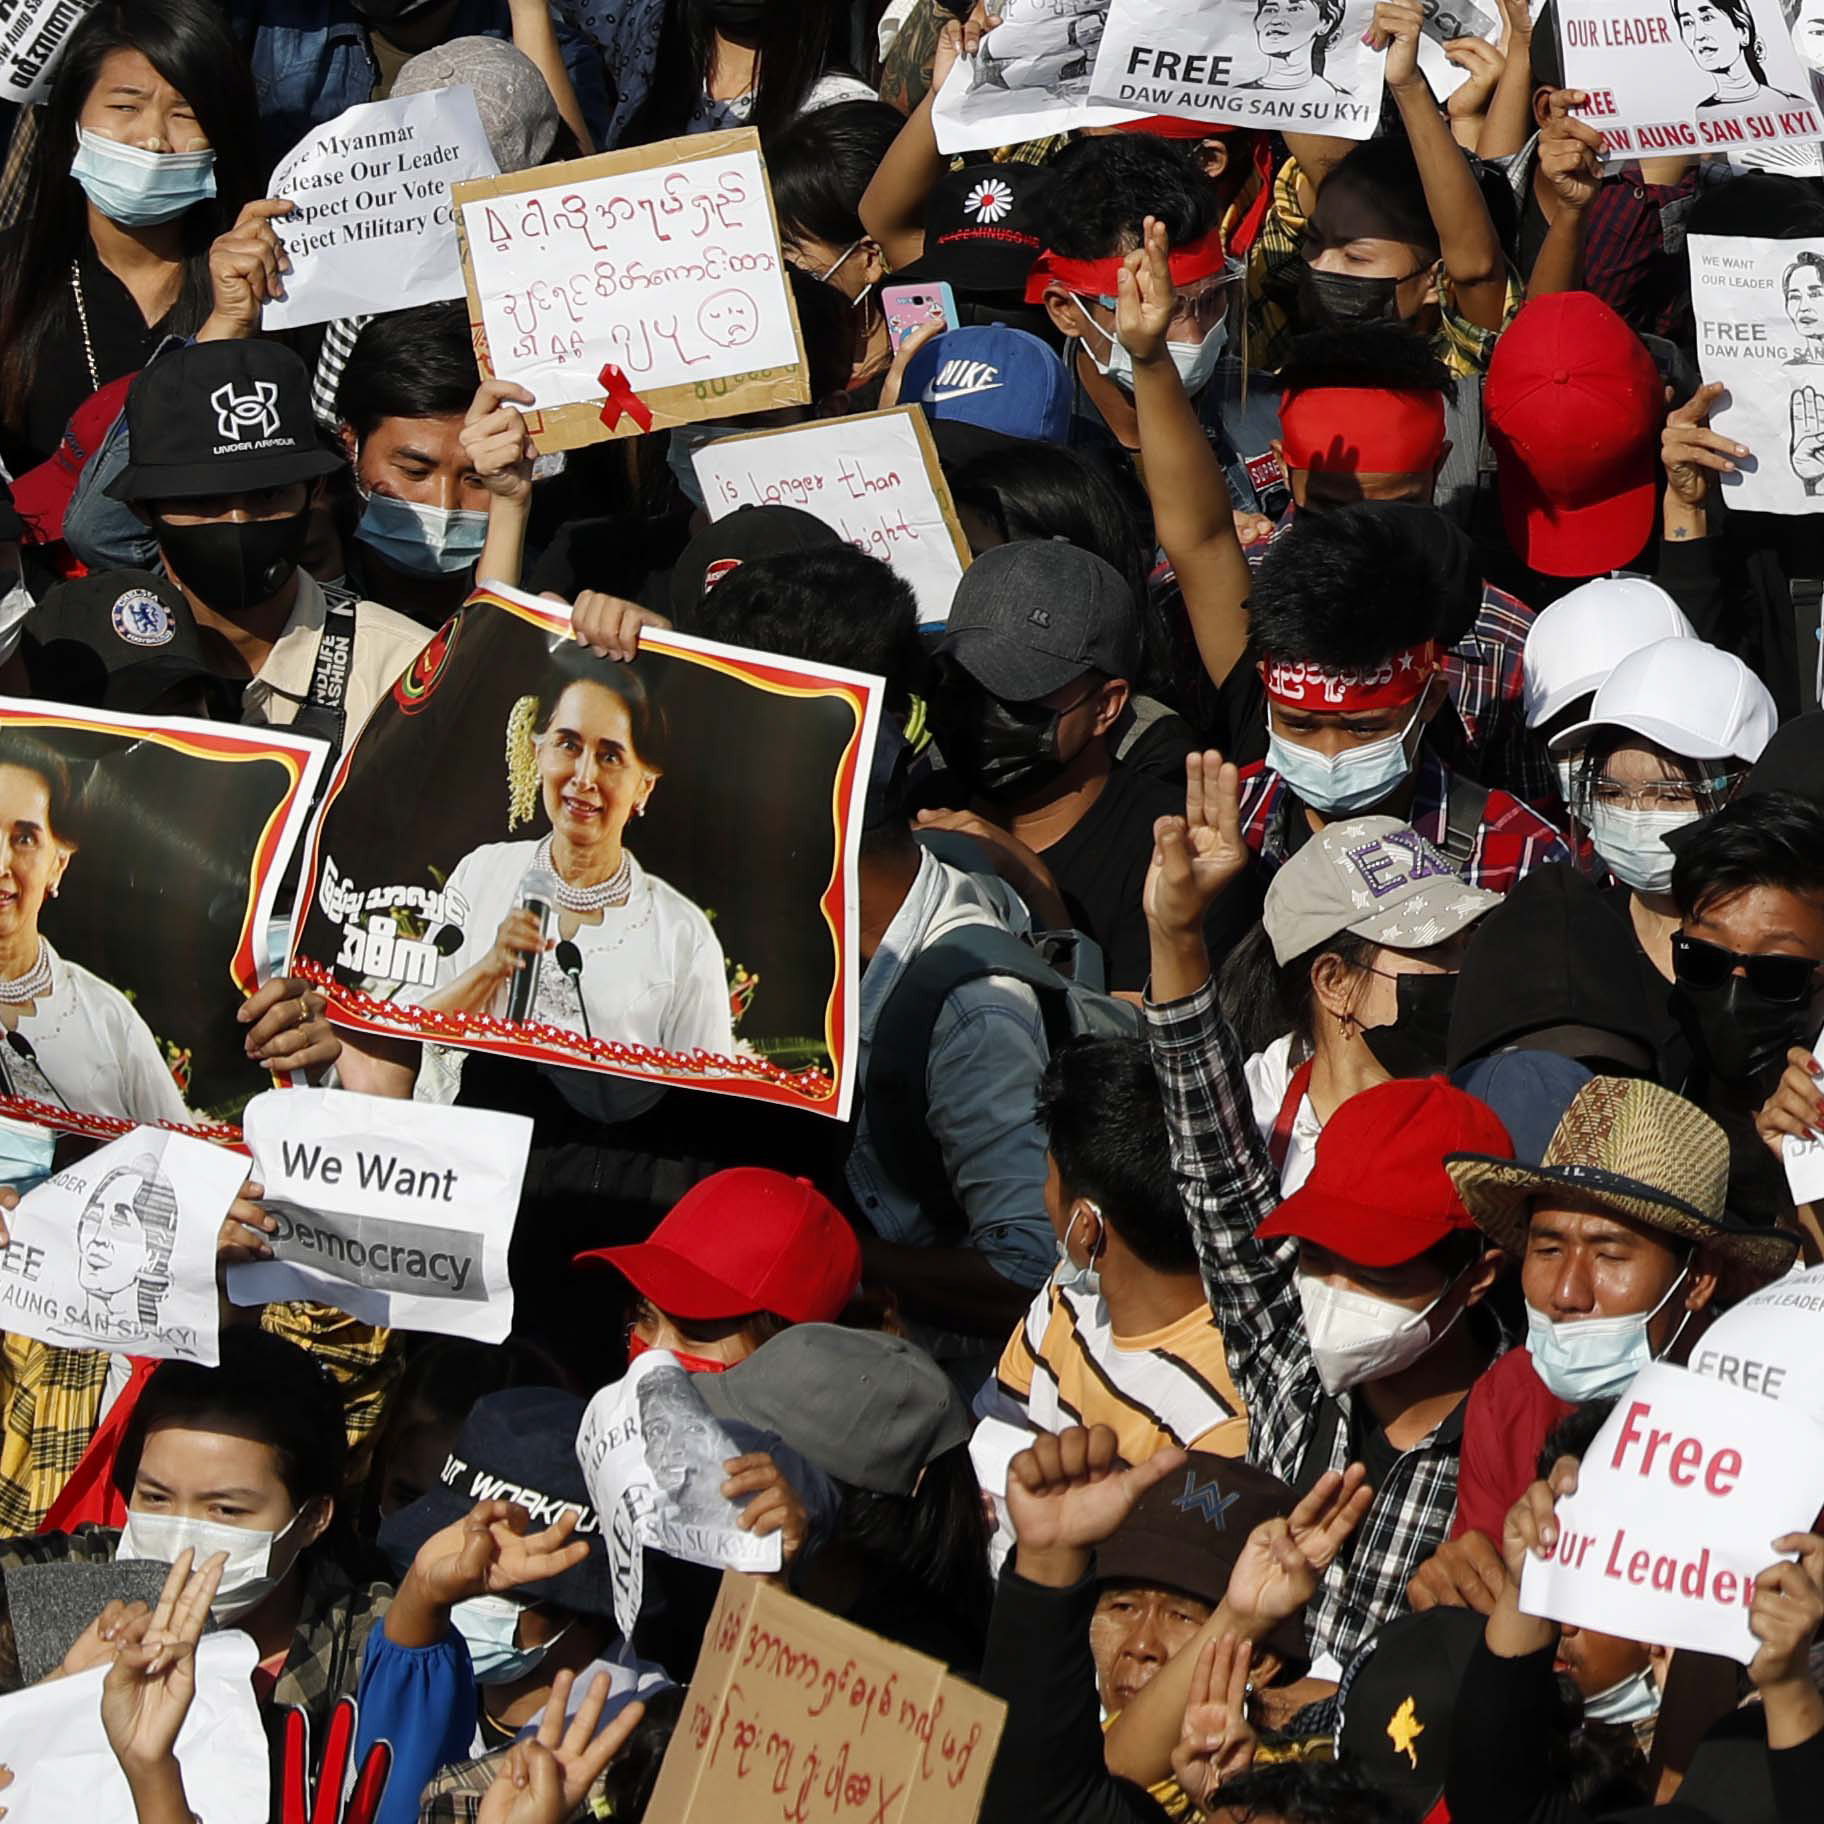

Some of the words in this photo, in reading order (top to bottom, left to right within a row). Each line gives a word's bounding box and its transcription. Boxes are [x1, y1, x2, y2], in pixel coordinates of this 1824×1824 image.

[1568, 20, 1597, 47] OUR
[1602, 15, 1671, 46] LEADER
[1126, 47, 1233, 88] FREE
[1119, 83, 1174, 106] DAW
[1178, 90, 1243, 110] AUNG
[1248, 94, 1295, 116] SAN
[1299, 100, 1328, 119] SU
[1334, 103, 1370, 124] KYI
[1600, 127, 1632, 152] AW
[1637, 123, 1695, 149] AUNG
[1701, 118, 1741, 143] SAN
[1746, 115, 1776, 138] SU
[1781, 112, 1819, 137] KYI
[1703, 322, 1767, 342] FREE
[1704, 344, 1739, 360] DAW
[1742, 345, 1789, 361] AUNG
[936, 360, 999, 389] NIKE
[213, 443, 250, 455] UNDER
[281, 1141, 348, 1185] We
[357, 1150, 458, 1202] Want
[266, 1208, 474, 1292] Democracy
[1610, 1401, 1742, 1498] Free
